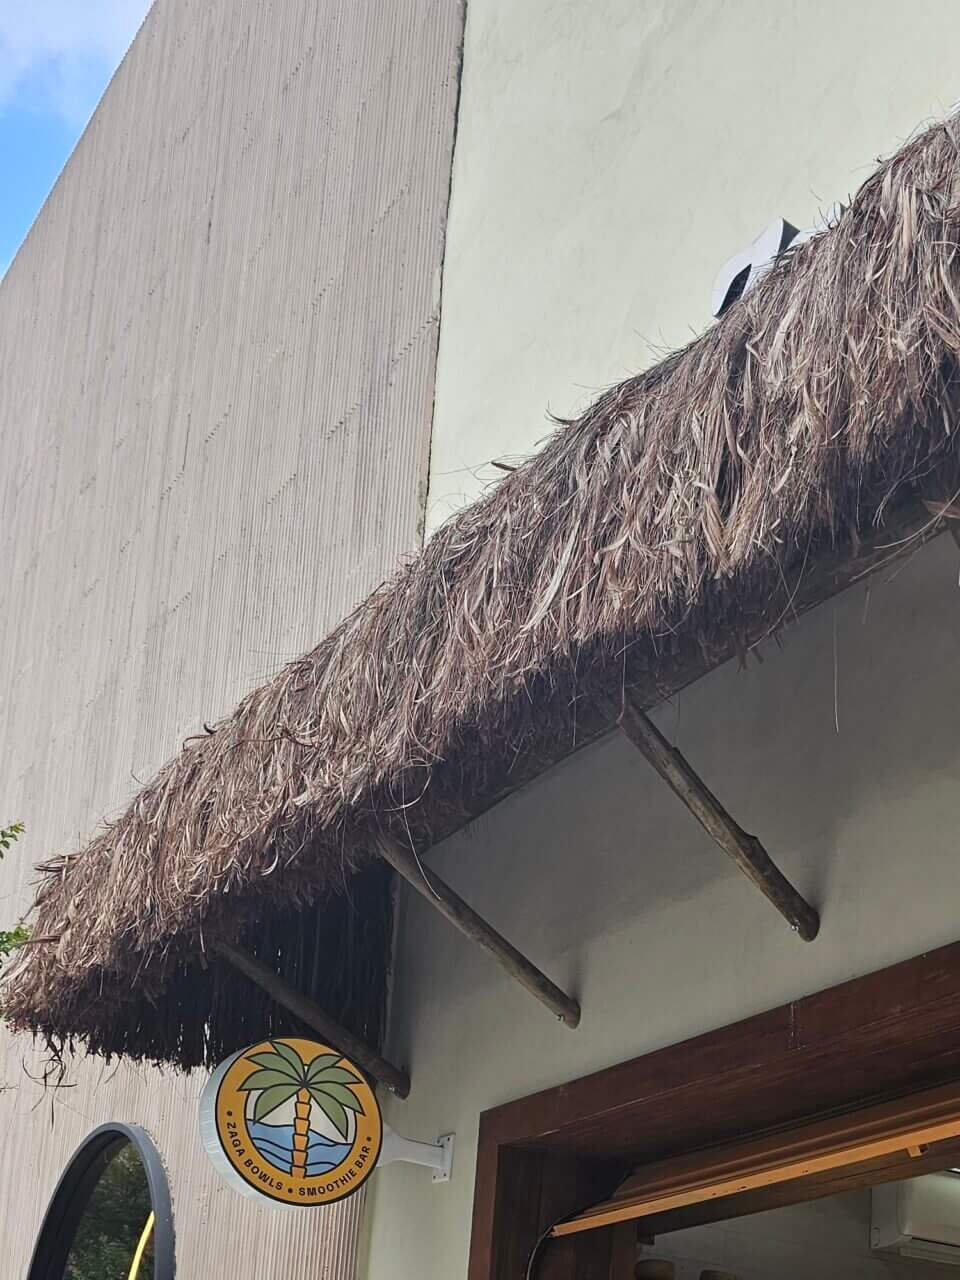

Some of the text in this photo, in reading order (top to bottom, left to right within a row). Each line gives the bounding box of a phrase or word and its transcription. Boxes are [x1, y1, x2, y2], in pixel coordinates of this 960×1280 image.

[226, 1121, 371, 1197] ZAGA BOWLS SMOOTHIE BAR
